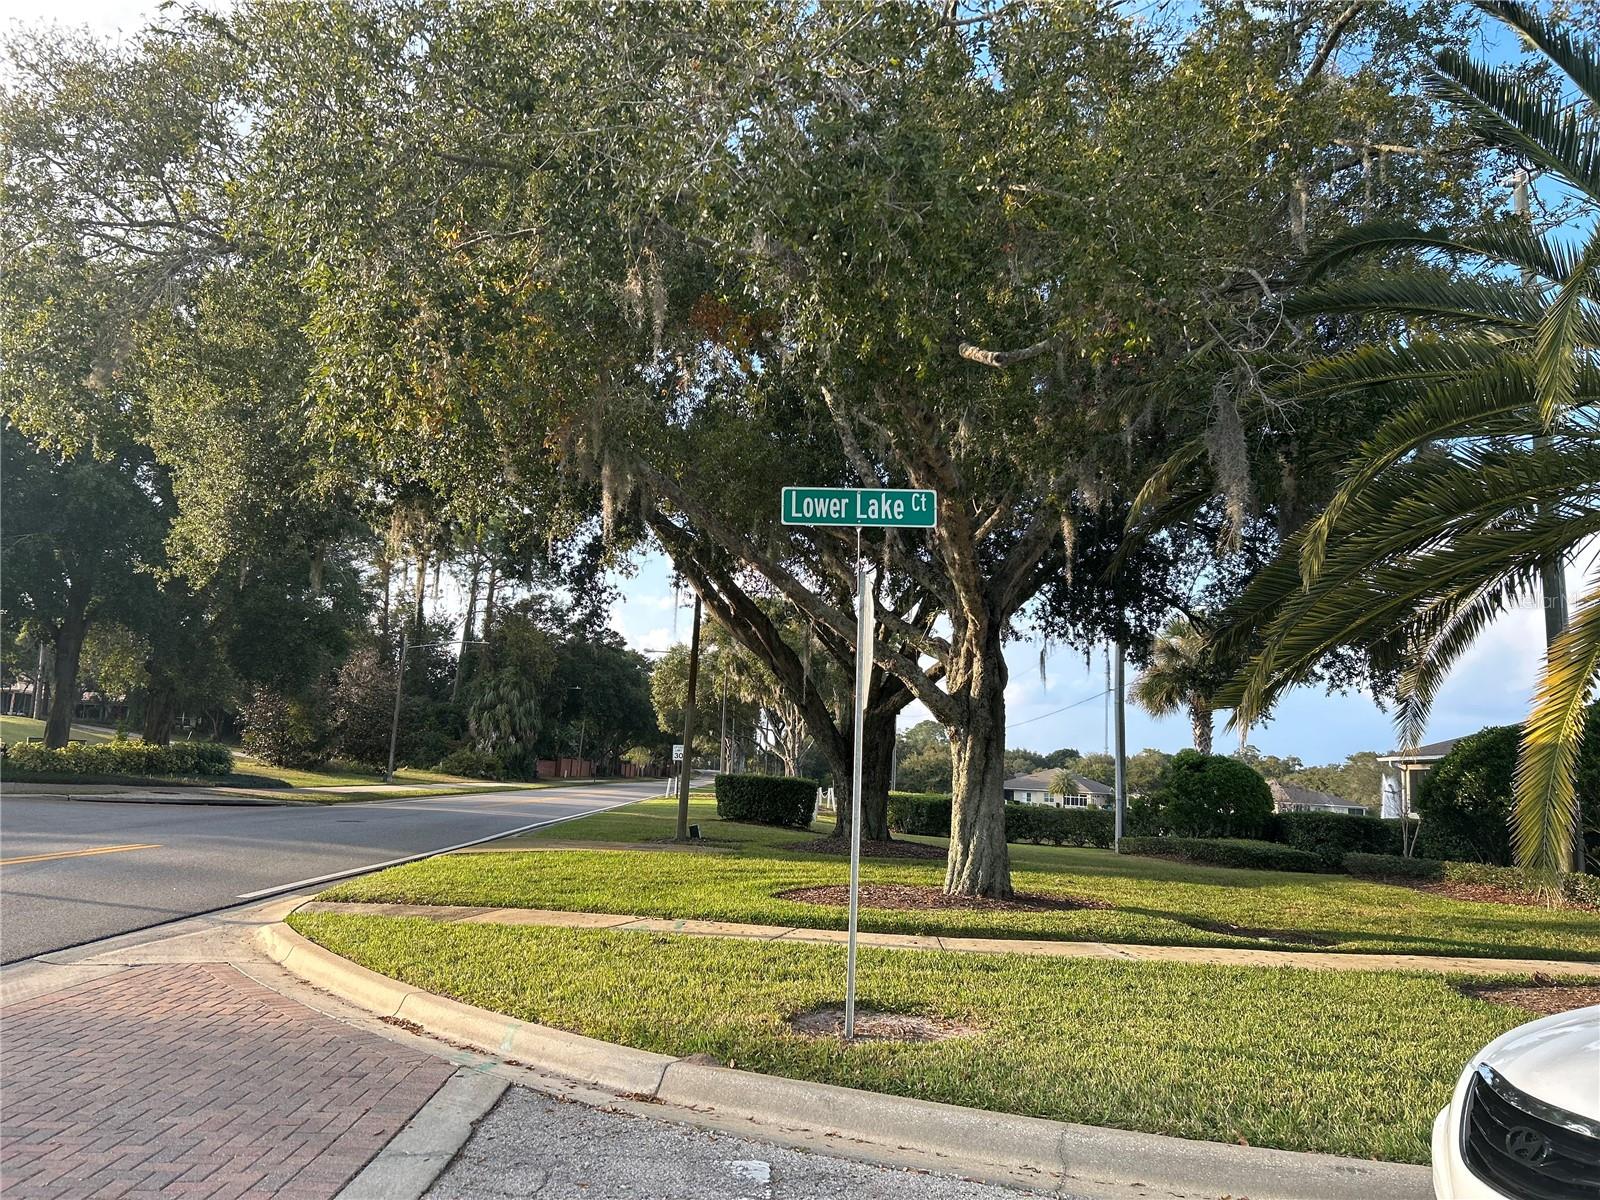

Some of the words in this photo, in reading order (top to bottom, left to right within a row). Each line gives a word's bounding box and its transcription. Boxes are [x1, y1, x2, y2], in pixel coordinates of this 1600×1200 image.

[791, 490, 849, 519] Lower
[856, 491, 904, 520] Lake
[911, 493, 927, 512] Ct
